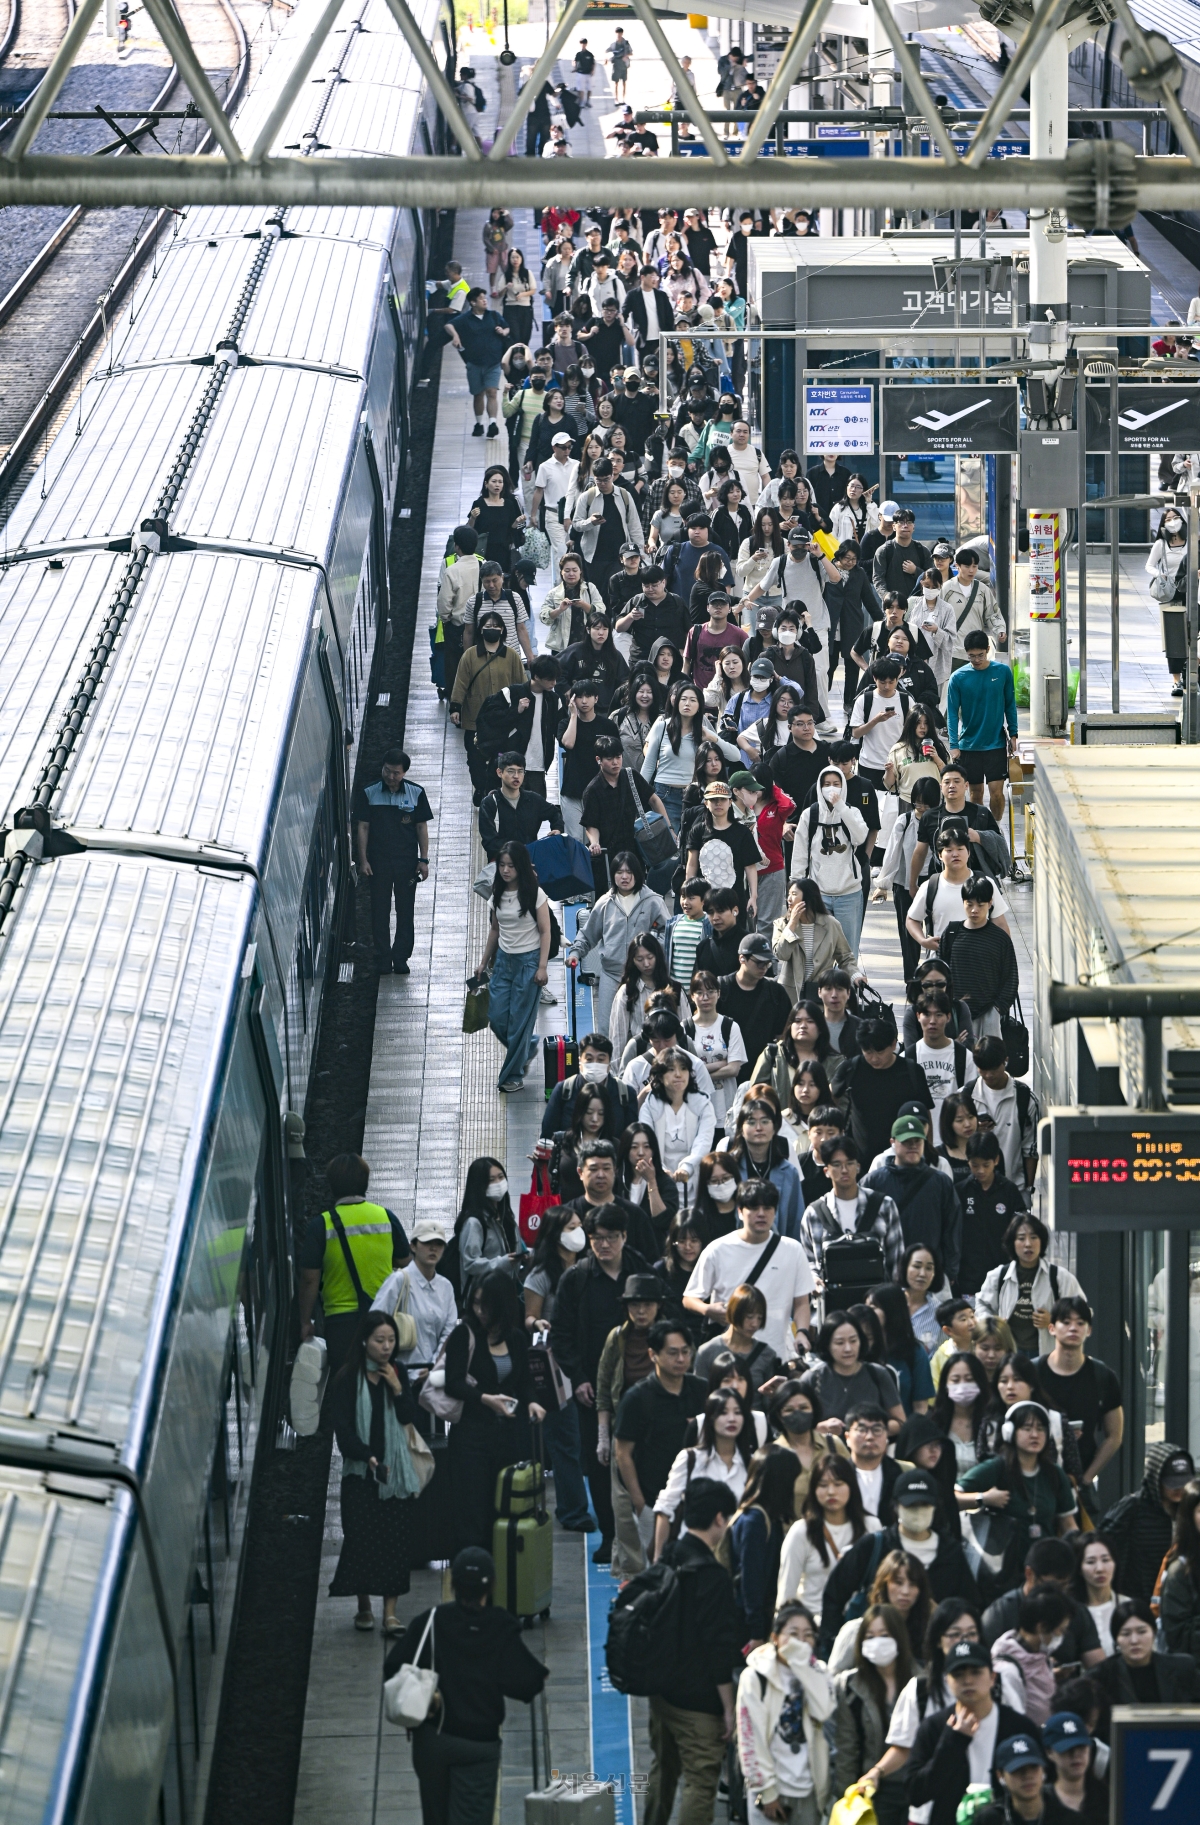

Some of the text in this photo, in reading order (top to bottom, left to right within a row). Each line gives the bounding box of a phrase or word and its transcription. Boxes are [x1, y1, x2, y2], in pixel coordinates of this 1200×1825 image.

[902, 291, 1012, 314] 고객대기실
[809, 407, 833, 416] KTX
[1034, 525, 1053, 535] 위험
[967, 1197, 974, 1205] 15
[1148, 1749, 1192, 1811] 7
